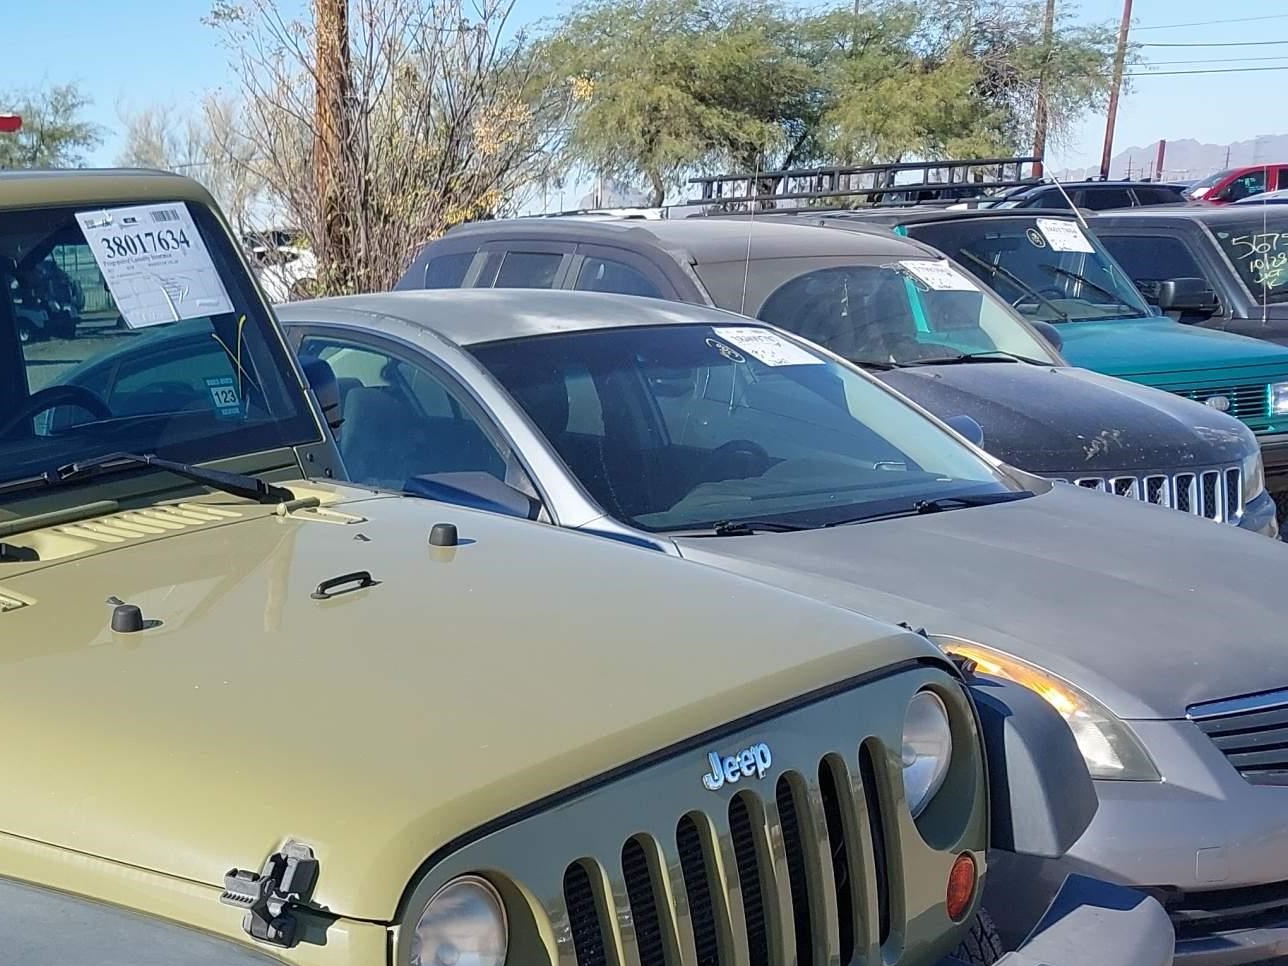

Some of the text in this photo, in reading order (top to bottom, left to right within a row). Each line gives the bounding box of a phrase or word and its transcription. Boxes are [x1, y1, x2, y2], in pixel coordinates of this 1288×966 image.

[102, 228, 190, 259] 38017634
[215, 390, 237, 404] 123
[703, 743, 772, 790] Jeep
